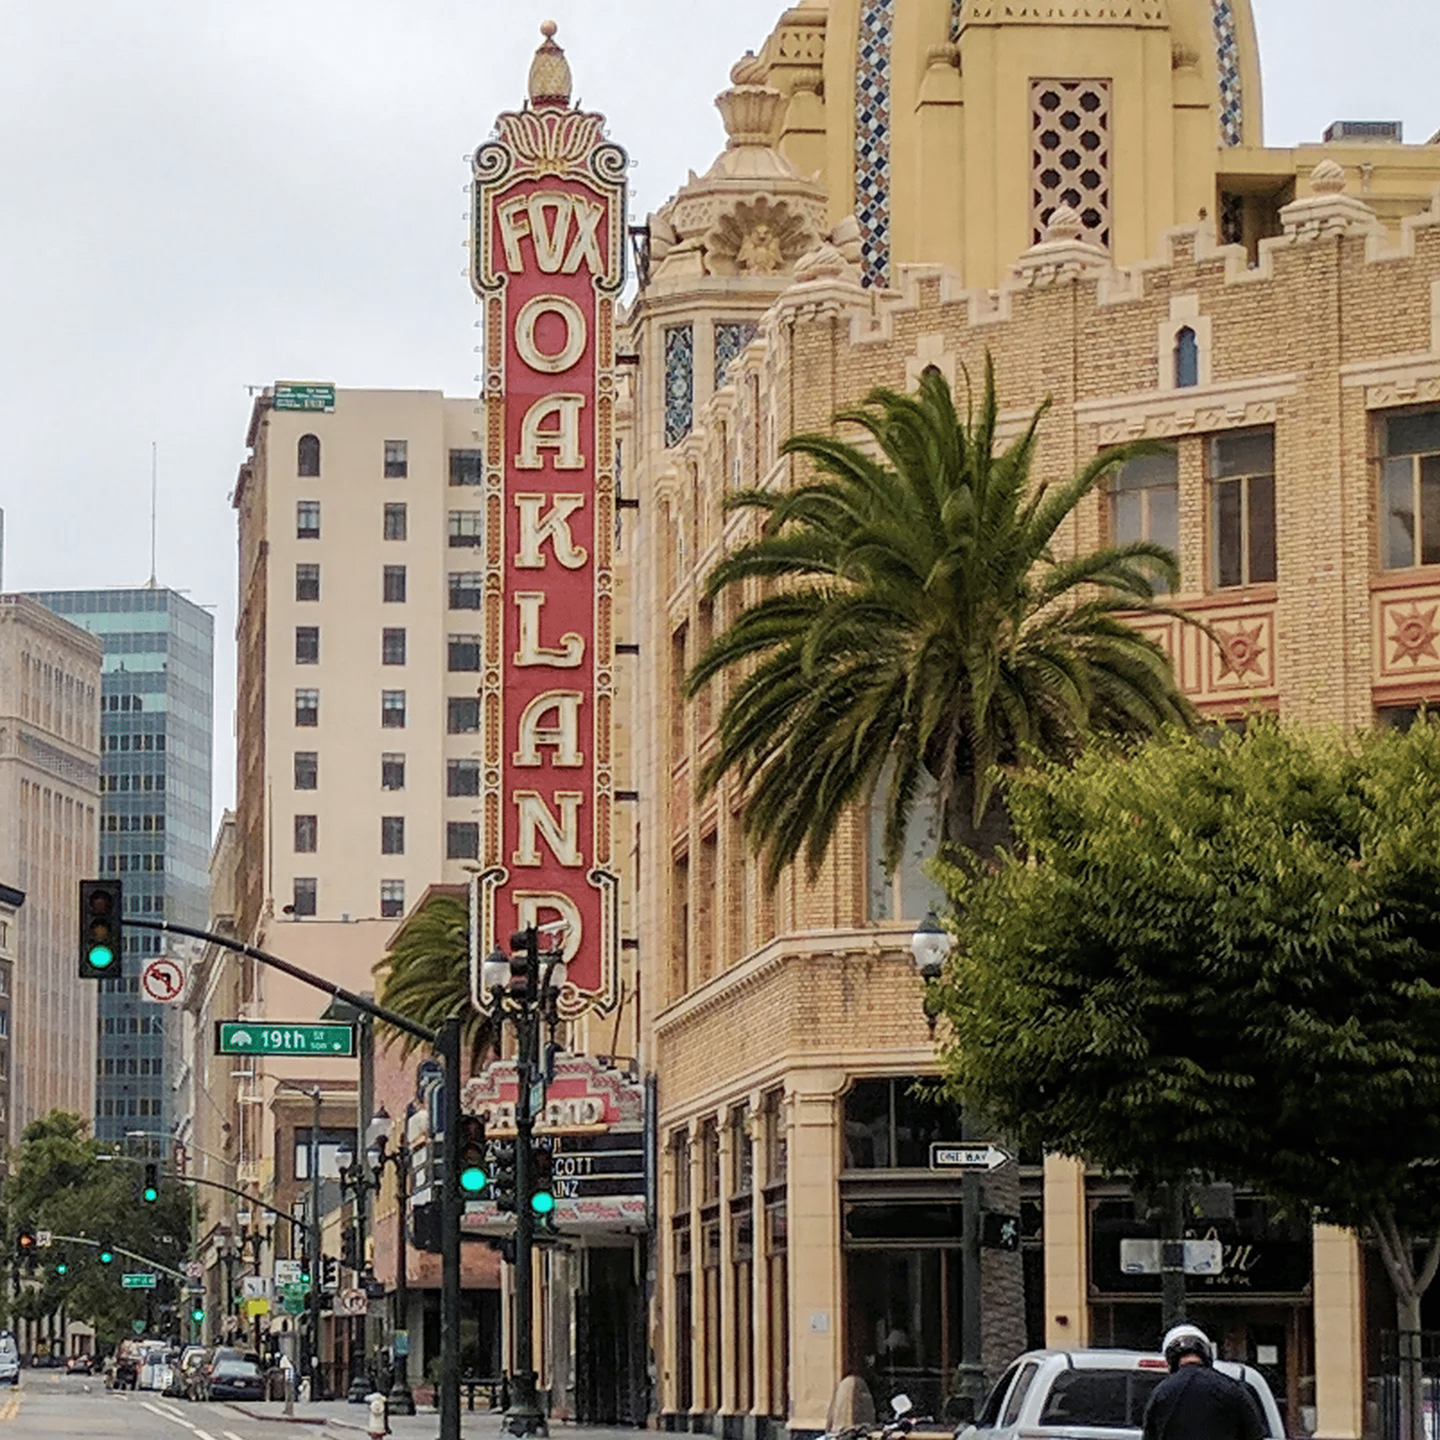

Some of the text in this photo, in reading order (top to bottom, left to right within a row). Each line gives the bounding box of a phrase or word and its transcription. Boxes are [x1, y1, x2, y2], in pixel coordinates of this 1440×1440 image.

[496, 190, 604, 274] FOX
[512, 293, 588, 972] OAKLAND
[261, 1030, 306, 1049] 19th
[551, 1158, 592, 1175] COTT
[939, 1152, 988, 1162] ONE WAY
